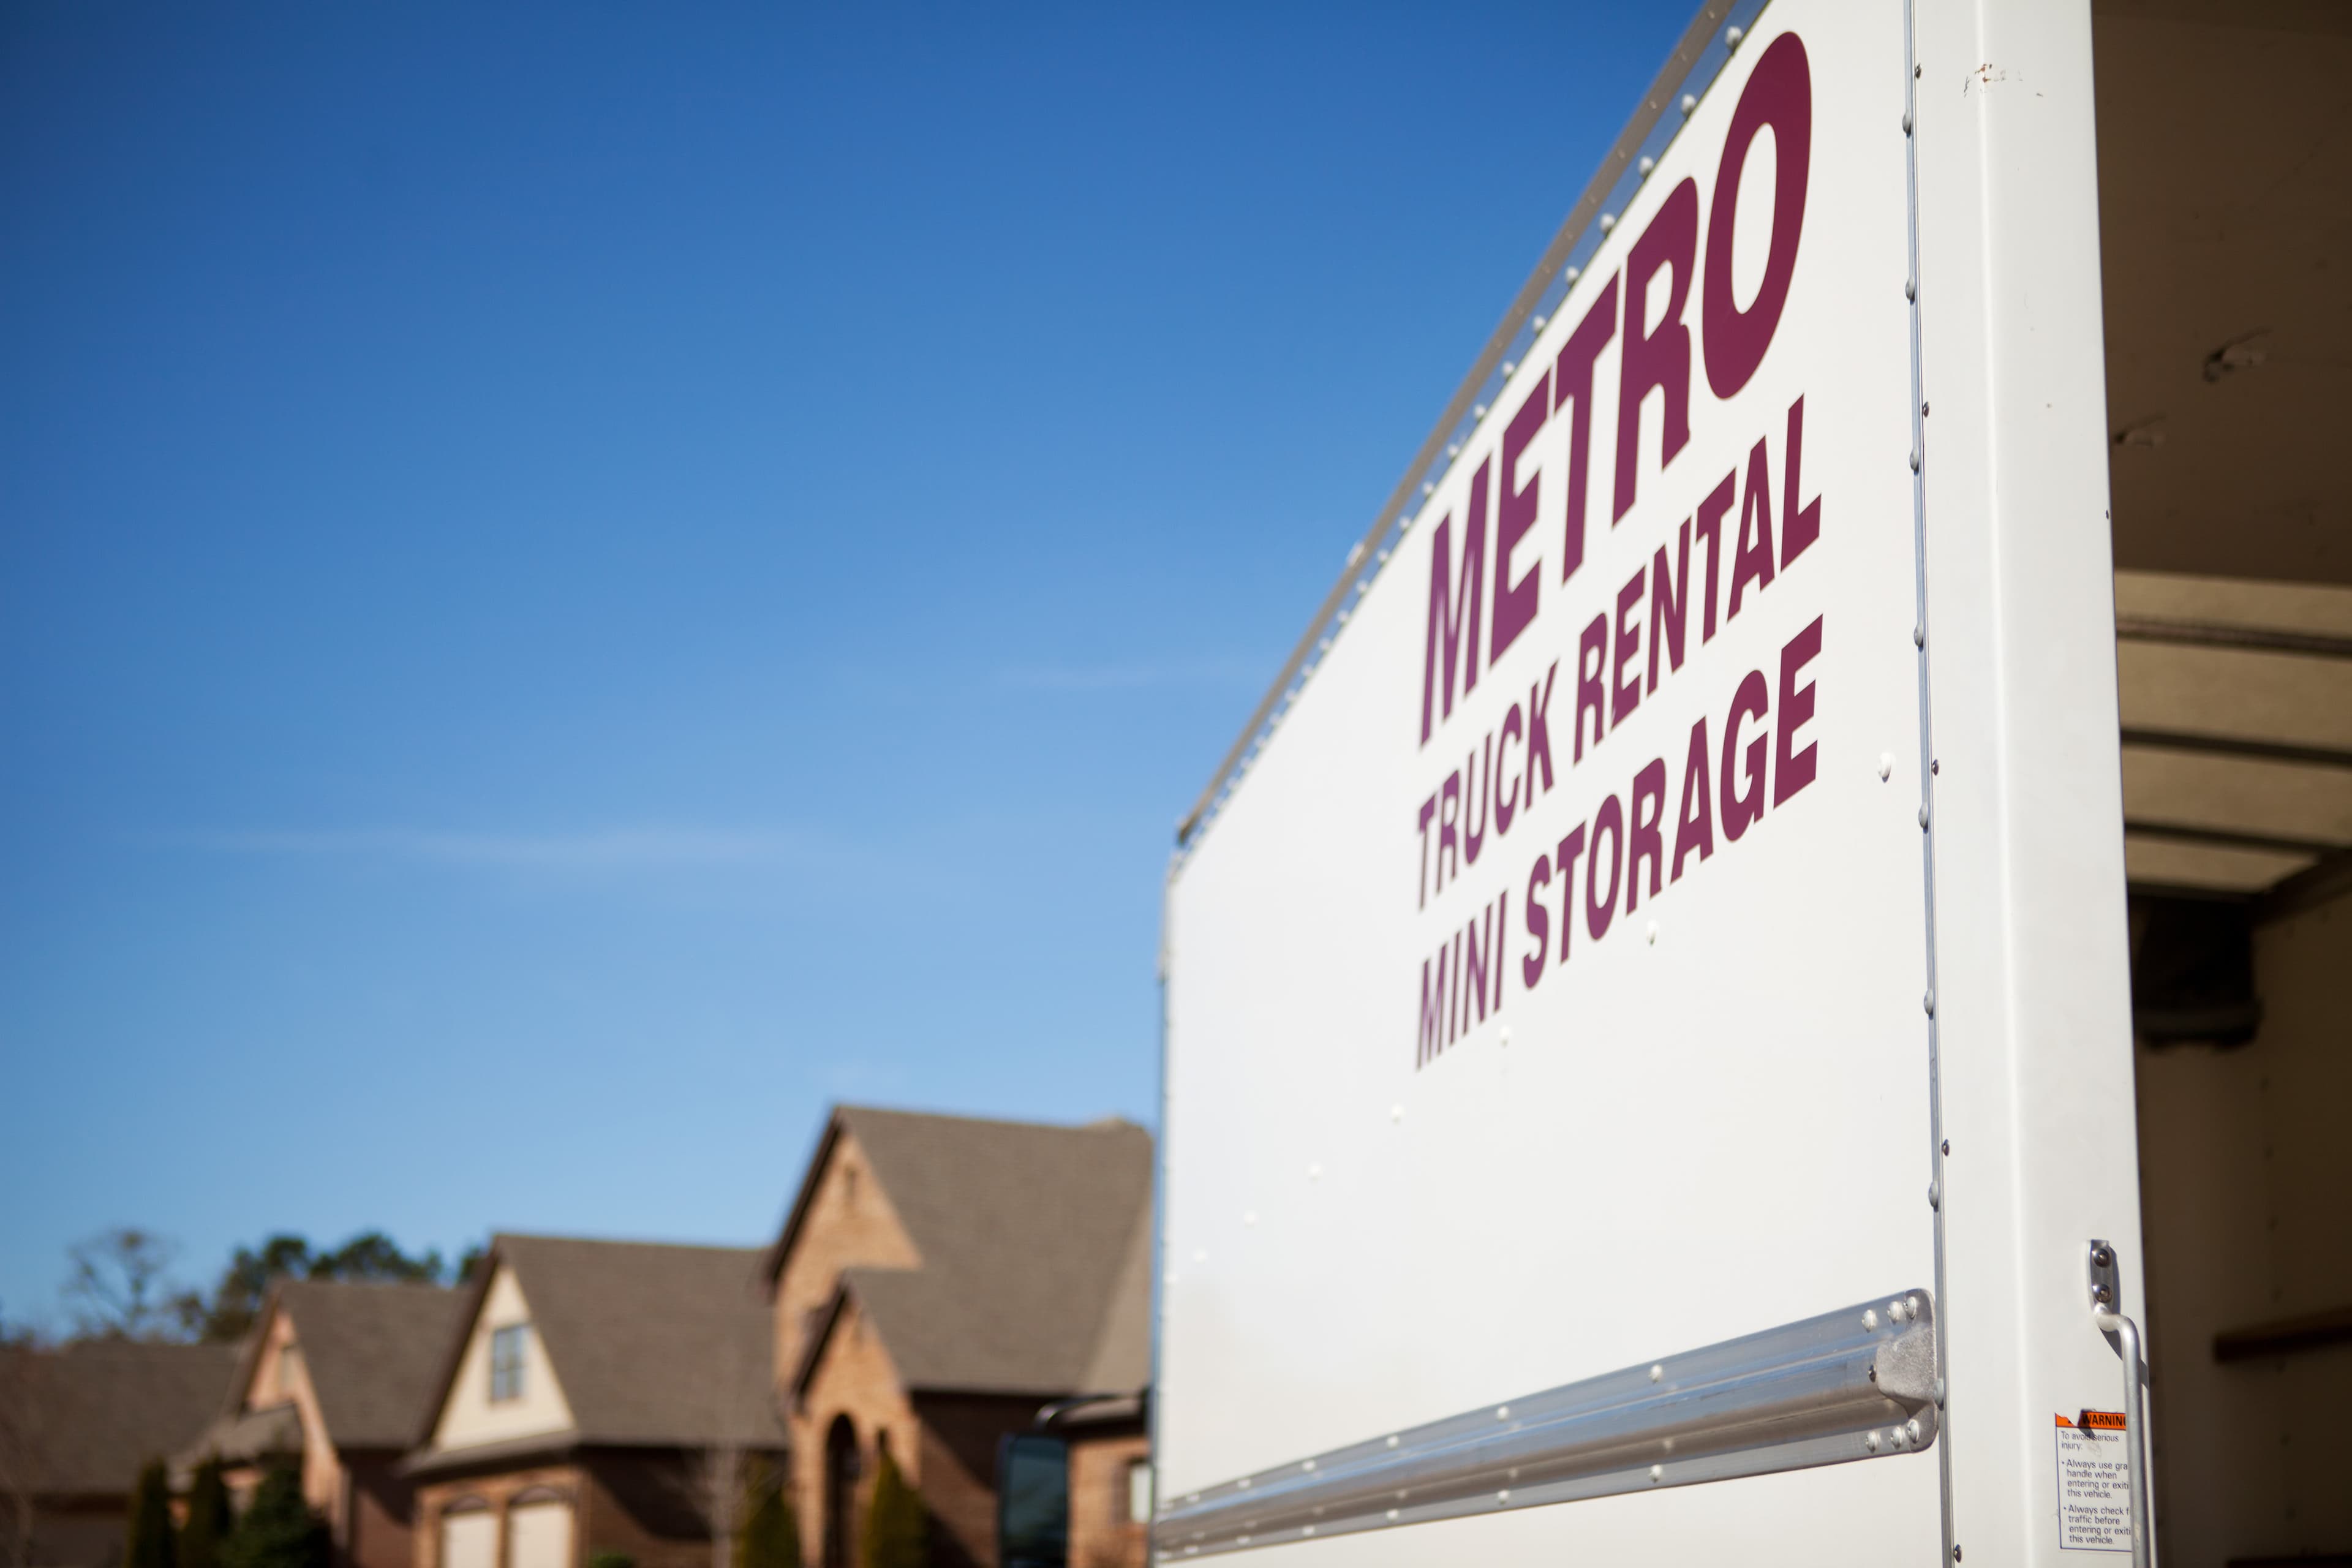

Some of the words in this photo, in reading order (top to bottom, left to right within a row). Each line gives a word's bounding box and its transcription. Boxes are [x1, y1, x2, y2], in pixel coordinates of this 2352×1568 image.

[1420, 31, 1812, 748] METRO
[1417, 658, 1557, 911] TRUCK
[1574, 394, 1822, 764] RENTAL
[1416, 890, 1509, 1071] MINI
[1523, 614, 1823, 990] STORAGE
[2061, 1430, 2070, 1439] To
[2072, 1432, 2092, 1441] avoid
[2094, 1433, 2119, 1442] serious
[2061, 1442, 2082, 1450] injury:
[2067, 1459, 2096, 1469] Always
[2067, 1469, 2092, 1478] handle
[2095, 1471, 2117, 1479] when
[2067, 1480, 2099, 1490] entering
[2113, 1481, 2129, 1490] exiti
[2067, 1488, 2082, 1498] this
[2084, 1490, 2113, 1499] vehicle.
[2068, 1504, 2098, 1515] Always
[2068, 1515, 2092, 1524] traffic
[2095, 1516, 2120, 1525] before
[2069, 1525, 2101, 1536] entering
[2069, 1534, 2083, 1543] this
[2086, 1536, 2114, 1545] vehicle.
